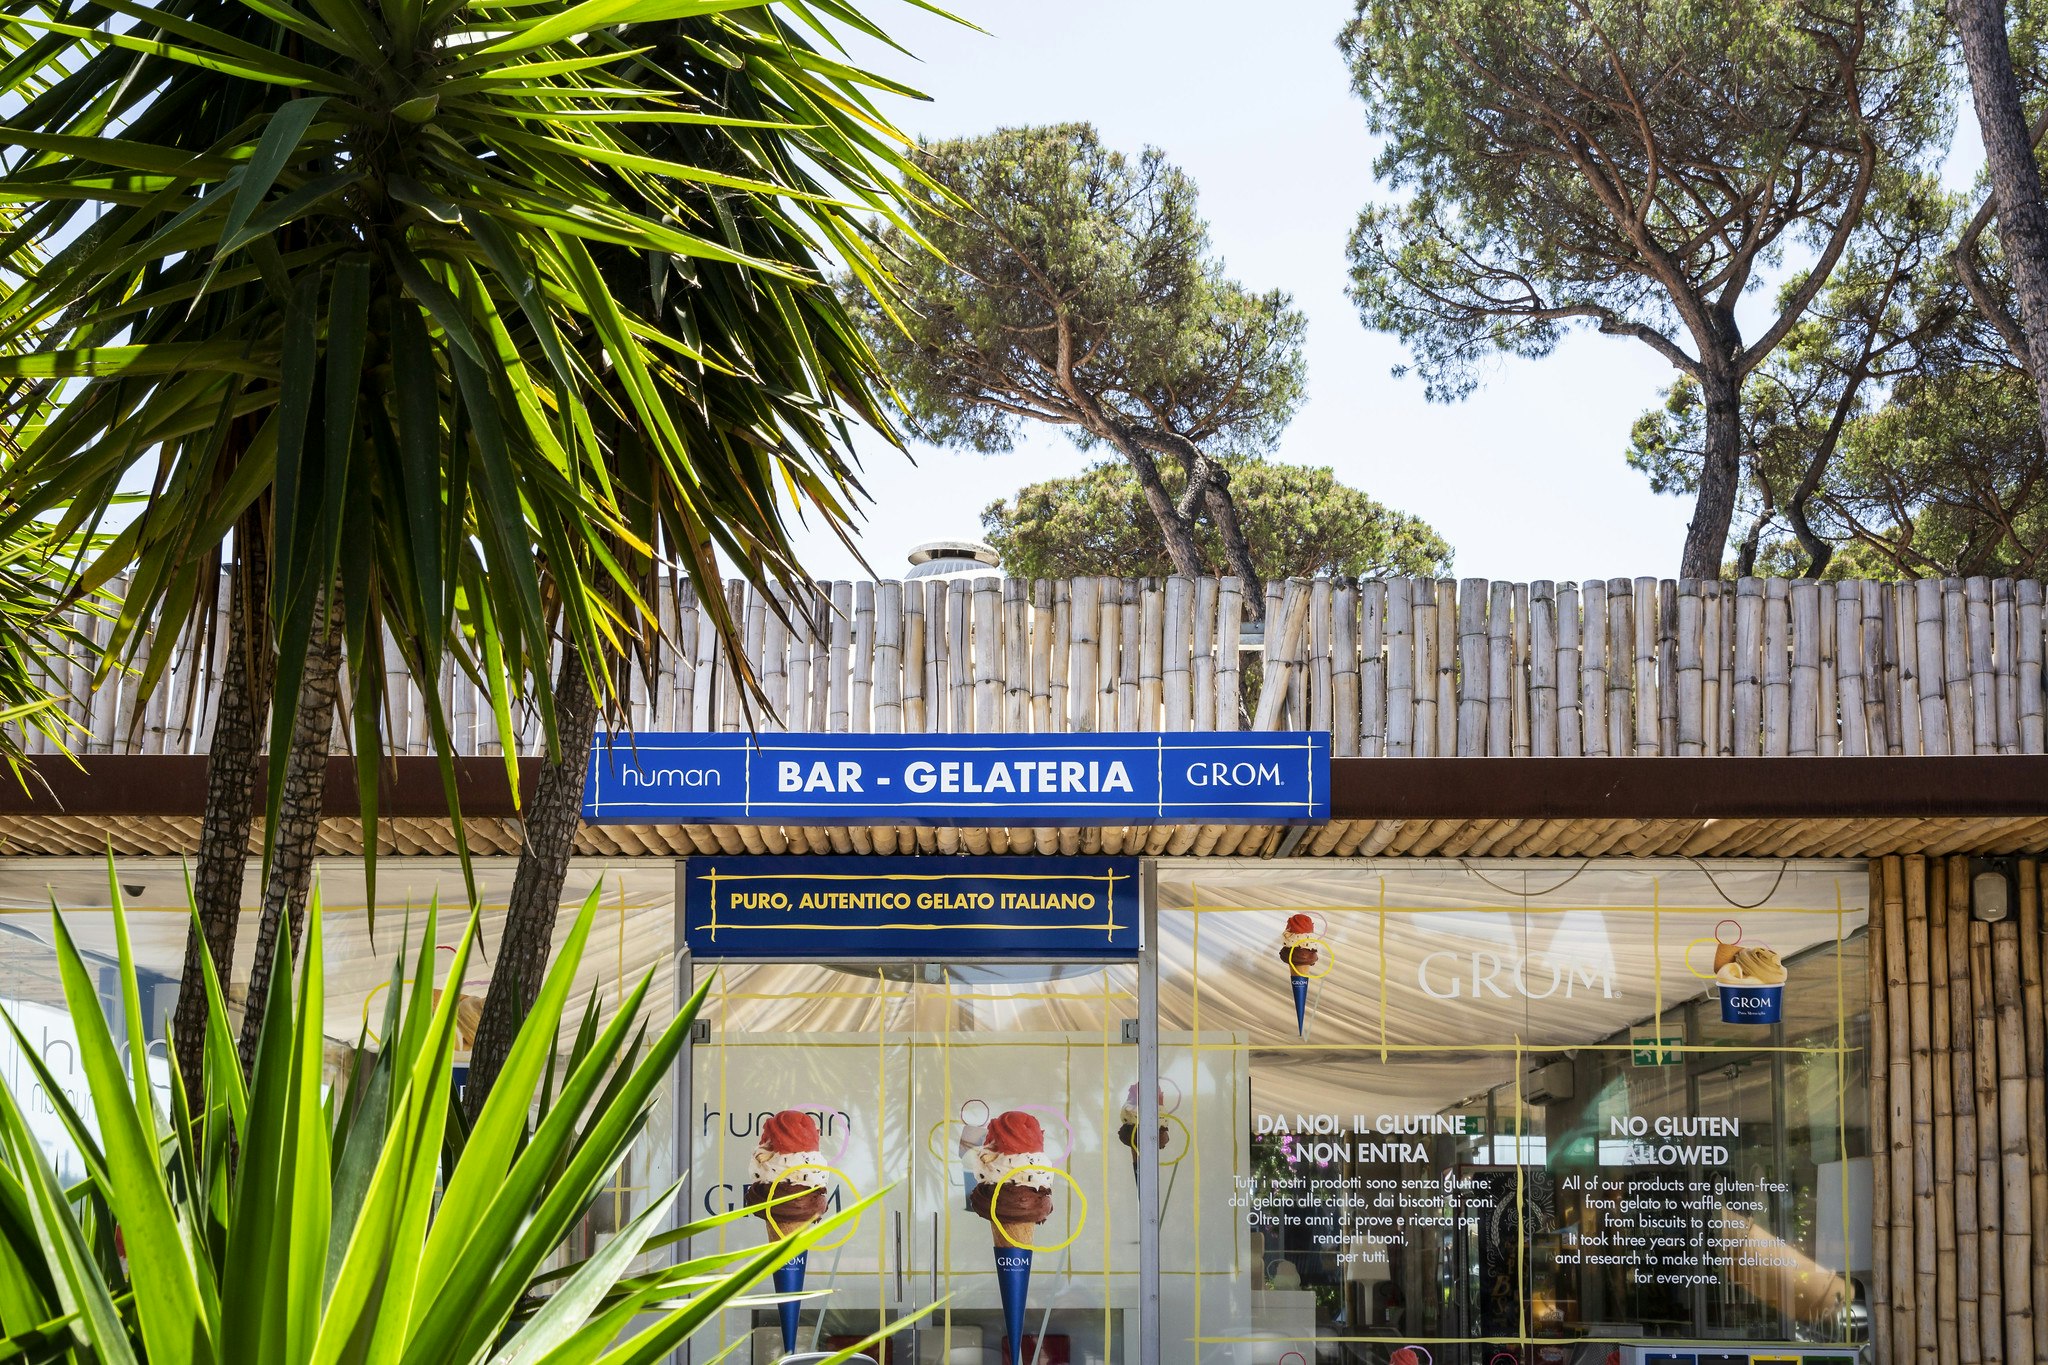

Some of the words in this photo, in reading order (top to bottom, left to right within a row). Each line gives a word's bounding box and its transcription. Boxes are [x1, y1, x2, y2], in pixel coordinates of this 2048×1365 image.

[622, 763, 721, 787] human
[778, 761, 864, 793] BAR
[877, 777, 891, 785] -
[904, 761, 1134, 794] GELATERIA
[731, 893, 793, 912] PURO,
[799, 893, 911, 910] AUTENTICO
[917, 893, 995, 910] GELATO
[1001, 893, 1096, 910] ITALIANO
[1730, 996, 1771, 1009] GROM
[1258, 1114, 1290, 1135] DA
[1296, 1114, 1346, 1137] NOI,
[1354, 1114, 1369, 1135] IL
[1375, 1114, 1466, 1135] GLUTINE
[1610, 1117, 1647, 1137] NO
[1654, 1117, 1739, 1137] GLUTEN
[1296, 1143, 1351, 1163] NON
[1358, 1143, 1429, 1163] ENTRA
[1626, 1145, 1729, 1165] ALLOWED
[1233, 1176, 1257, 1190] Tutti
[1263, 1176, 1266, 1190] i
[1272, 1176, 1306, 1190] nostri
[1311, 1176, 1361, 1193] prodotti
[1367, 1179, 1397, 1190] sono
[1402, 1179, 1439, 1190] senza
[1443, 1176, 1492, 1193] glutine:
[1562, 1176, 1580, 1191] All
[1585, 1176, 1598, 1191] of
[1602, 1181, 1623, 1191] our
[1628, 1176, 1684, 1195] products
[1689, 1181, 1711, 1191] are
[1715, 1176, 1789, 1195] gluten-free:
[1228, 1194, 1249, 1207] dal
[1254, 1194, 1293, 1211] gelato
[1298, 1194, 1321, 1207] alle
[1325, 1194, 1369, 1210] cialde,
[1373, 1194, 1394, 1207] dai
[1399, 1194, 1444, 1207] biscotti
[1449, 1194, 1462, 1207] ai
[1466, 1194, 1497, 1207] coni.
[1585, 1195, 1616, 1210] from
[1620, 1195, 1661, 1213] gelato
[1665, 1195, 1677, 1210] to
[1681, 1195, 1721, 1210] waffle
[1725, 1199, 1768, 1212] cones,
[1246, 1212, 1280, 1226] Oltre
[1284, 1212, 1301, 1226] tre
[1305, 1212, 1334, 1226] anni
[1340, 1212, 1351, 1226] di
[1356, 1216, 1392, 1230] prove
[1397, 1216, 1405, 1226] e
[1408, 1212, 1453, 1226] ricerca
[1458, 1216, 1480, 1230] per
[1604, 1213, 1635, 1228] from
[1639, 1213, 1686, 1228] biscuits
[1690, 1213, 1703, 1228] to
[1313, 1230, 1363, 1244] renderli
[1368, 1230, 1409, 1247] buoni,
[1569, 1232, 1577, 1246] It
[1580, 1232, 1608, 1246] took
[1613, 1232, 1645, 1246] three
[1650, 1236, 1685, 1250] years
[1689, 1232, 1703, 1246] of
[1707, 1232, 1786, 1250] experiments
[997, 1256, 1029, 1266] GROM
[1337, 1252, 1358, 1266] per
[1362, 1250, 1390, 1263] tutti.
[1555, 1250, 1580, 1265] and
[1585, 1250, 1640, 1265] research
[1645, 1250, 1657, 1265] to
[1662, 1250, 1698, 1265] make
[1702, 1250, 1734, 1265] them
[1634, 1269, 1653, 1284] for
[1656, 1273, 1721, 1288] everyone.
